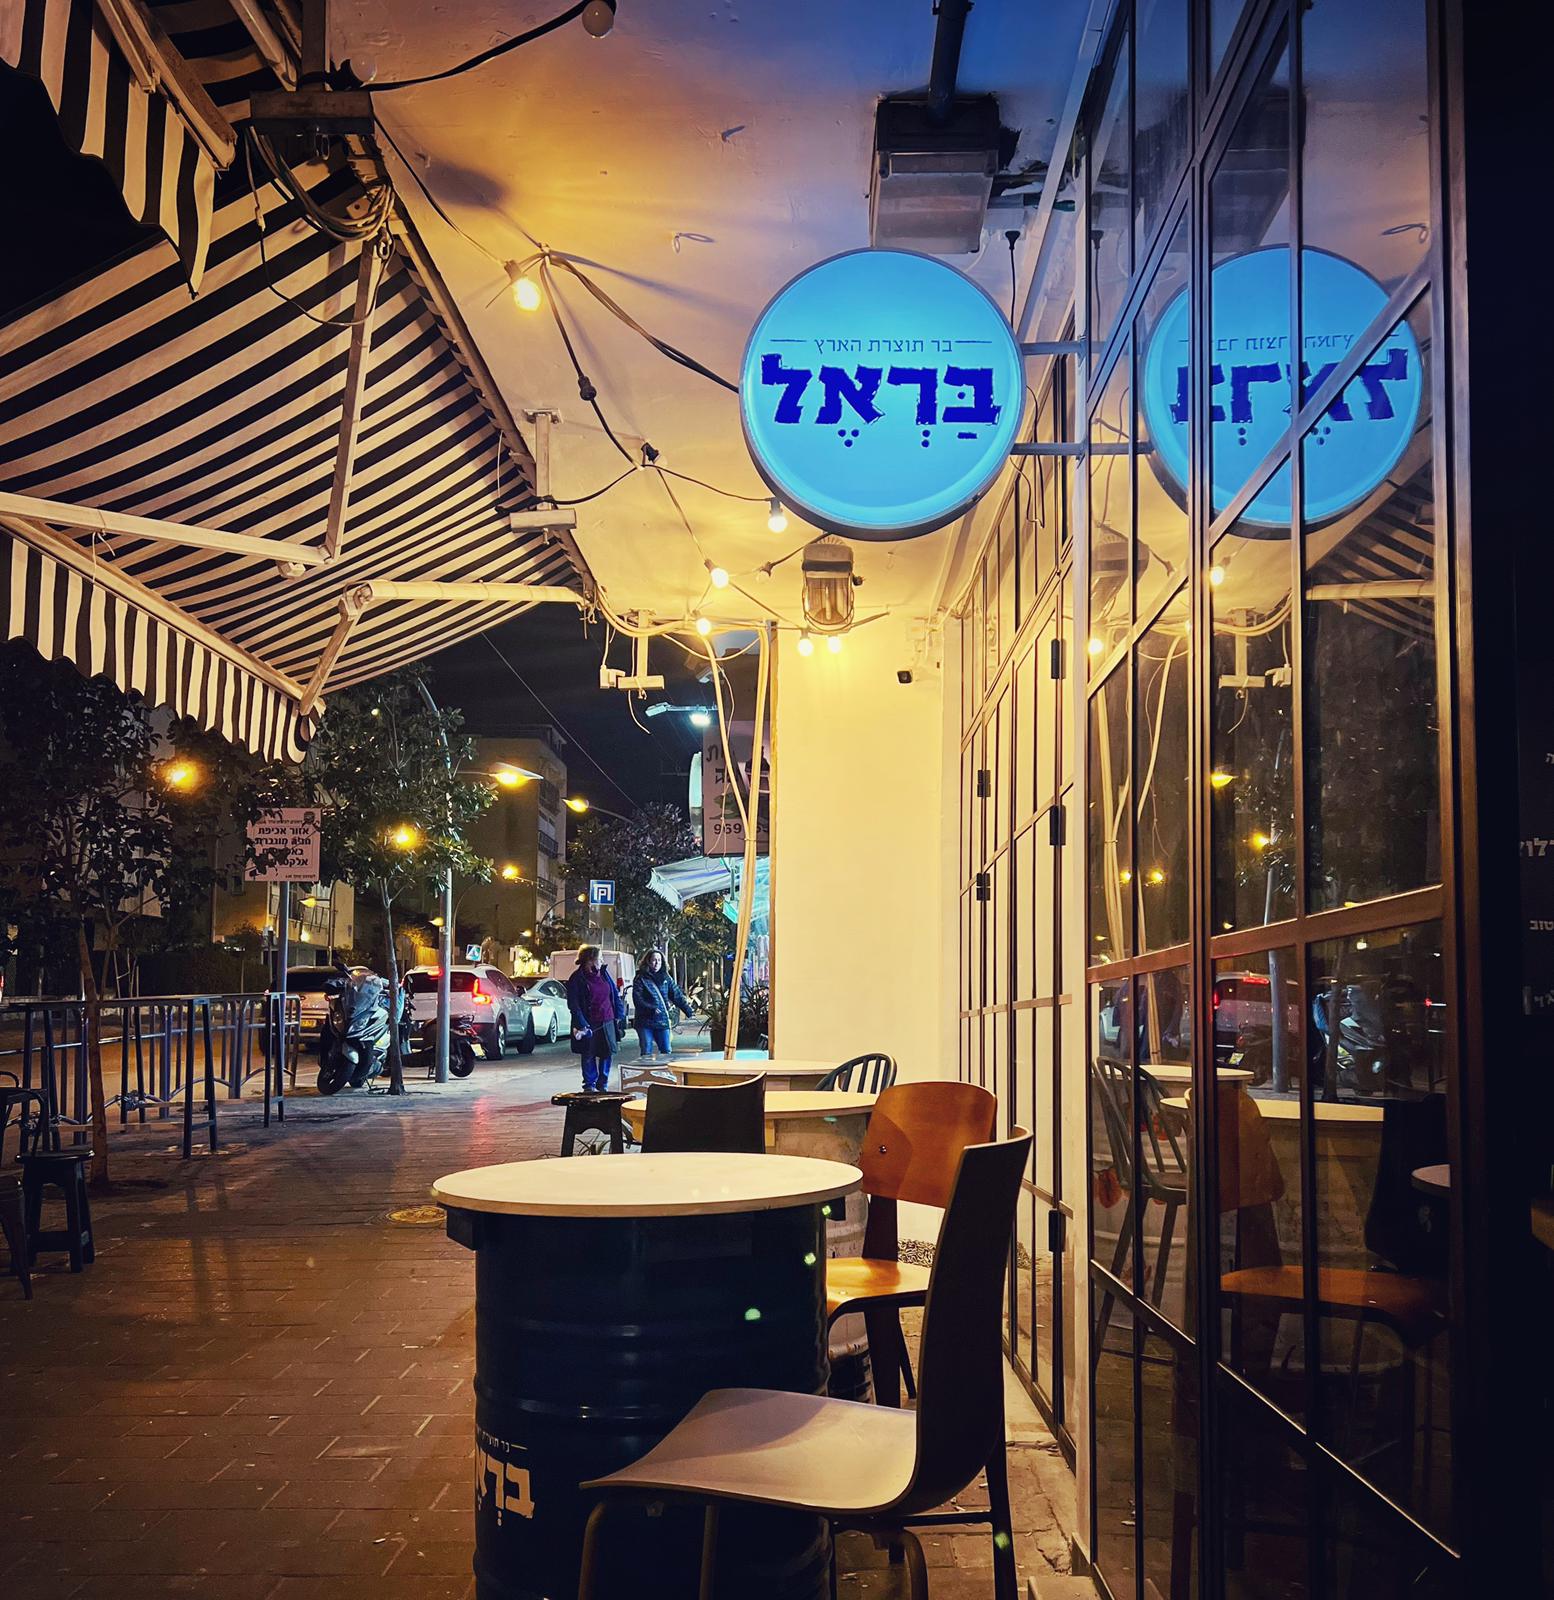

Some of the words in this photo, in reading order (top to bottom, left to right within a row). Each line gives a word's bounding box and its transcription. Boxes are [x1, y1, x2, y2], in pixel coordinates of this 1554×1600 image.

[814, 339, 862, 354] הארץ
[867, 339, 924, 352] תוצרת
[931, 340, 952, 352] בר
[258, 827, 287, 835] אכיפת
[290, 827, 309, 835] אזור
